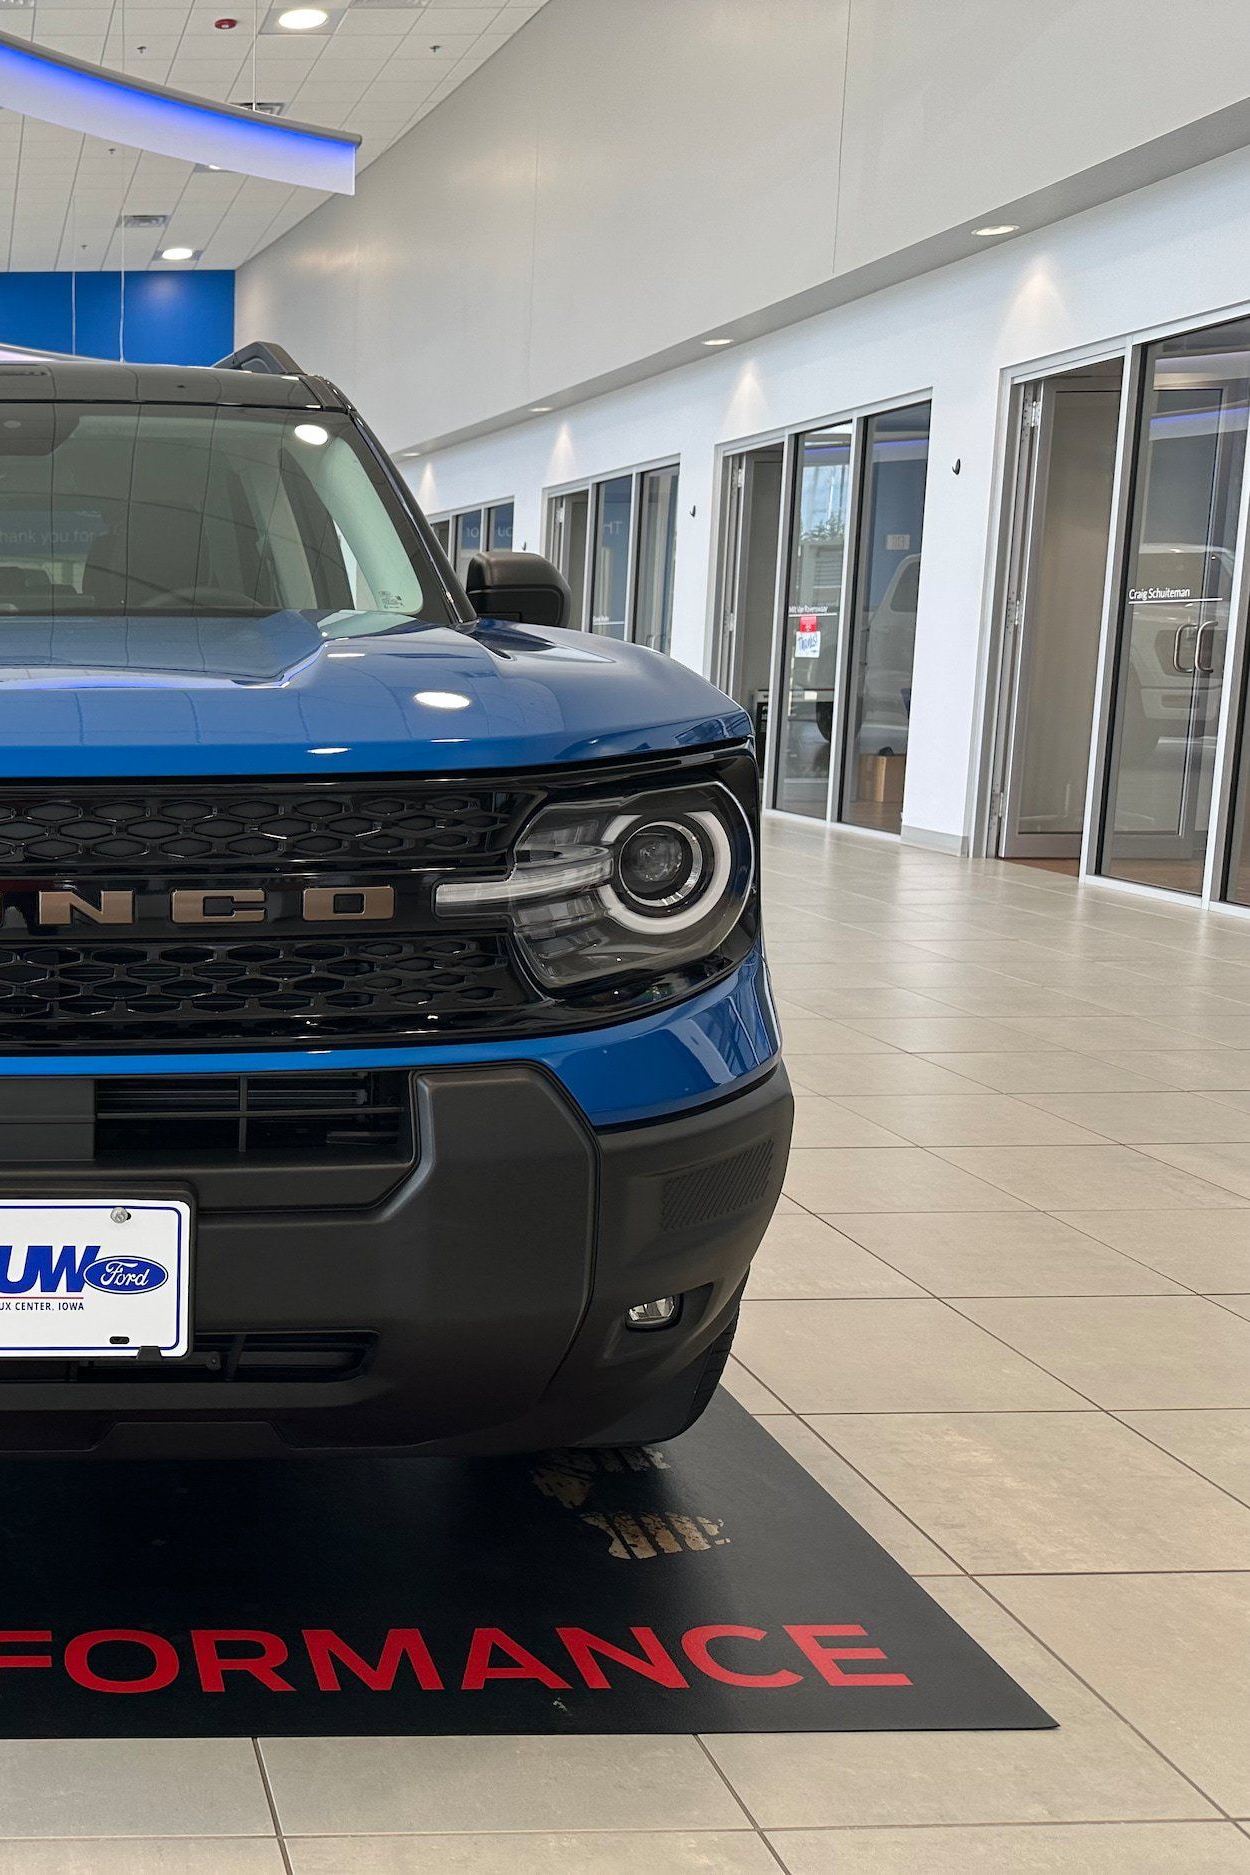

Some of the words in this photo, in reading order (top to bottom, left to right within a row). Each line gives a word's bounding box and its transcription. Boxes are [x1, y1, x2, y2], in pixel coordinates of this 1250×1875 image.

[1129, 589, 1148, 601] Craig
[100, 1261, 151, 1287] Ford
[58, 1302, 85, 1311] IOWA
